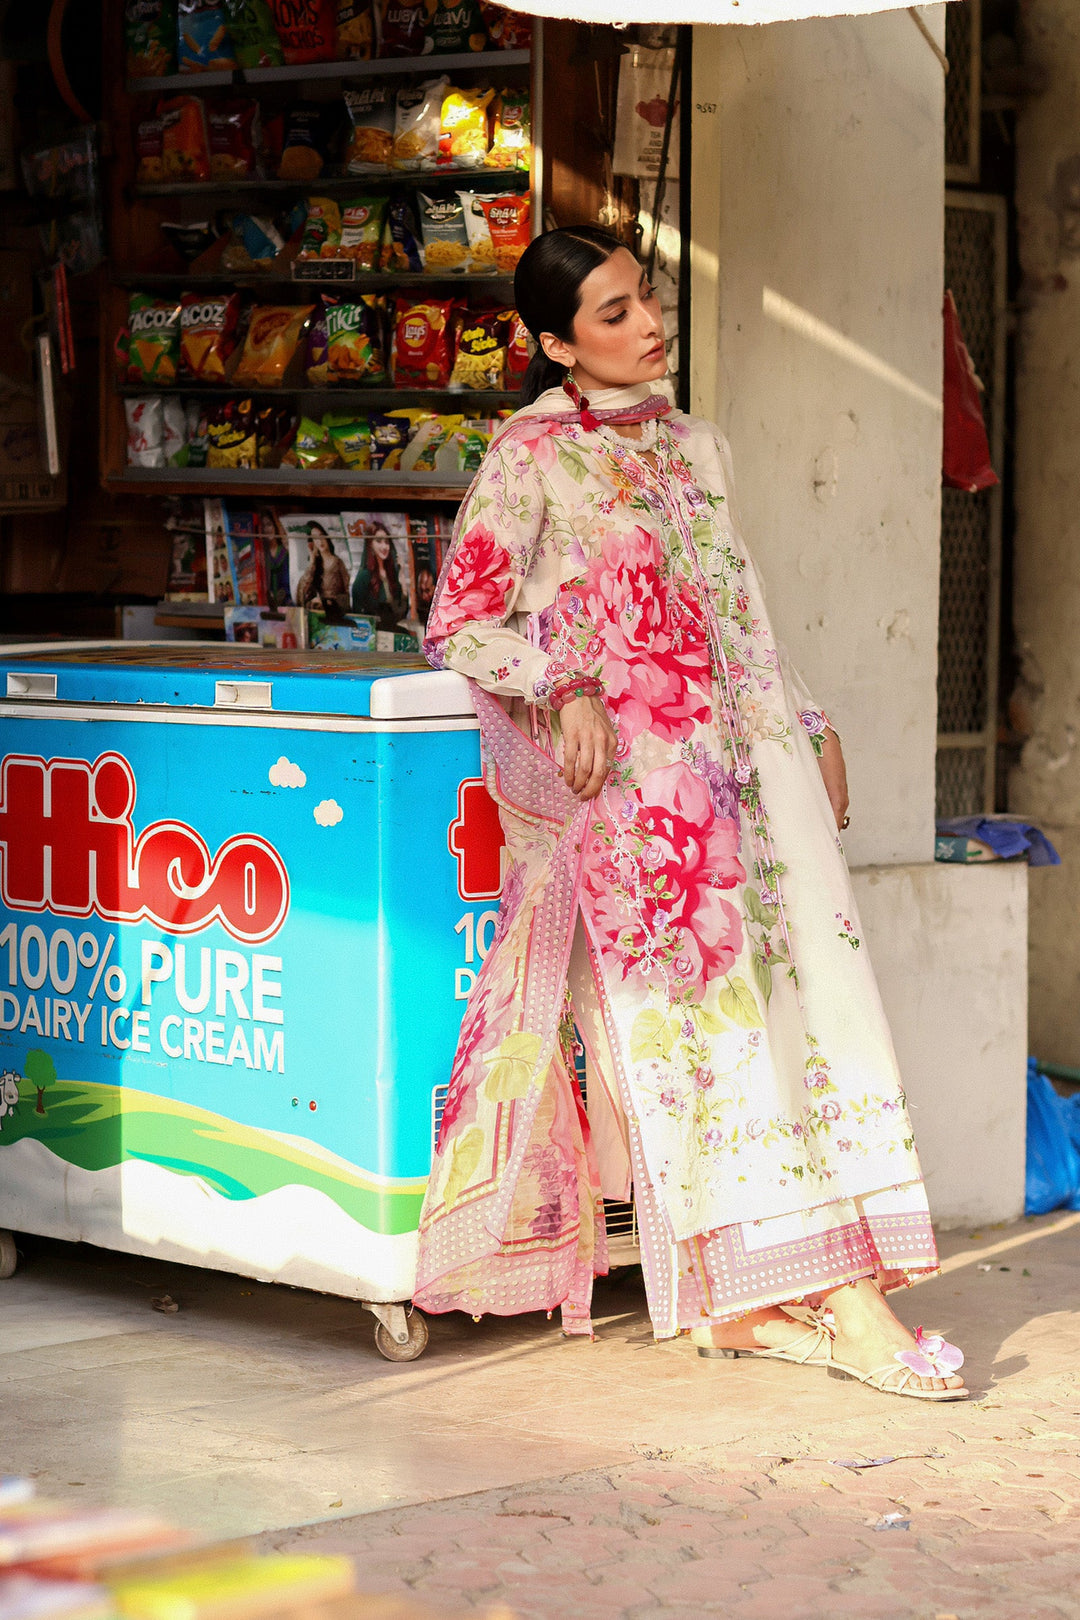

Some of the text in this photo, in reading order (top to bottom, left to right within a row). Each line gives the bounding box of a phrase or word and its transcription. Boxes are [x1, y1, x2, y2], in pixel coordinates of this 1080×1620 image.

[181, 304, 224, 327] ACOZ
[0, 923, 284, 1025] 100% PURE
[0, 990, 285, 1074] DAIRY ICE CREAM
